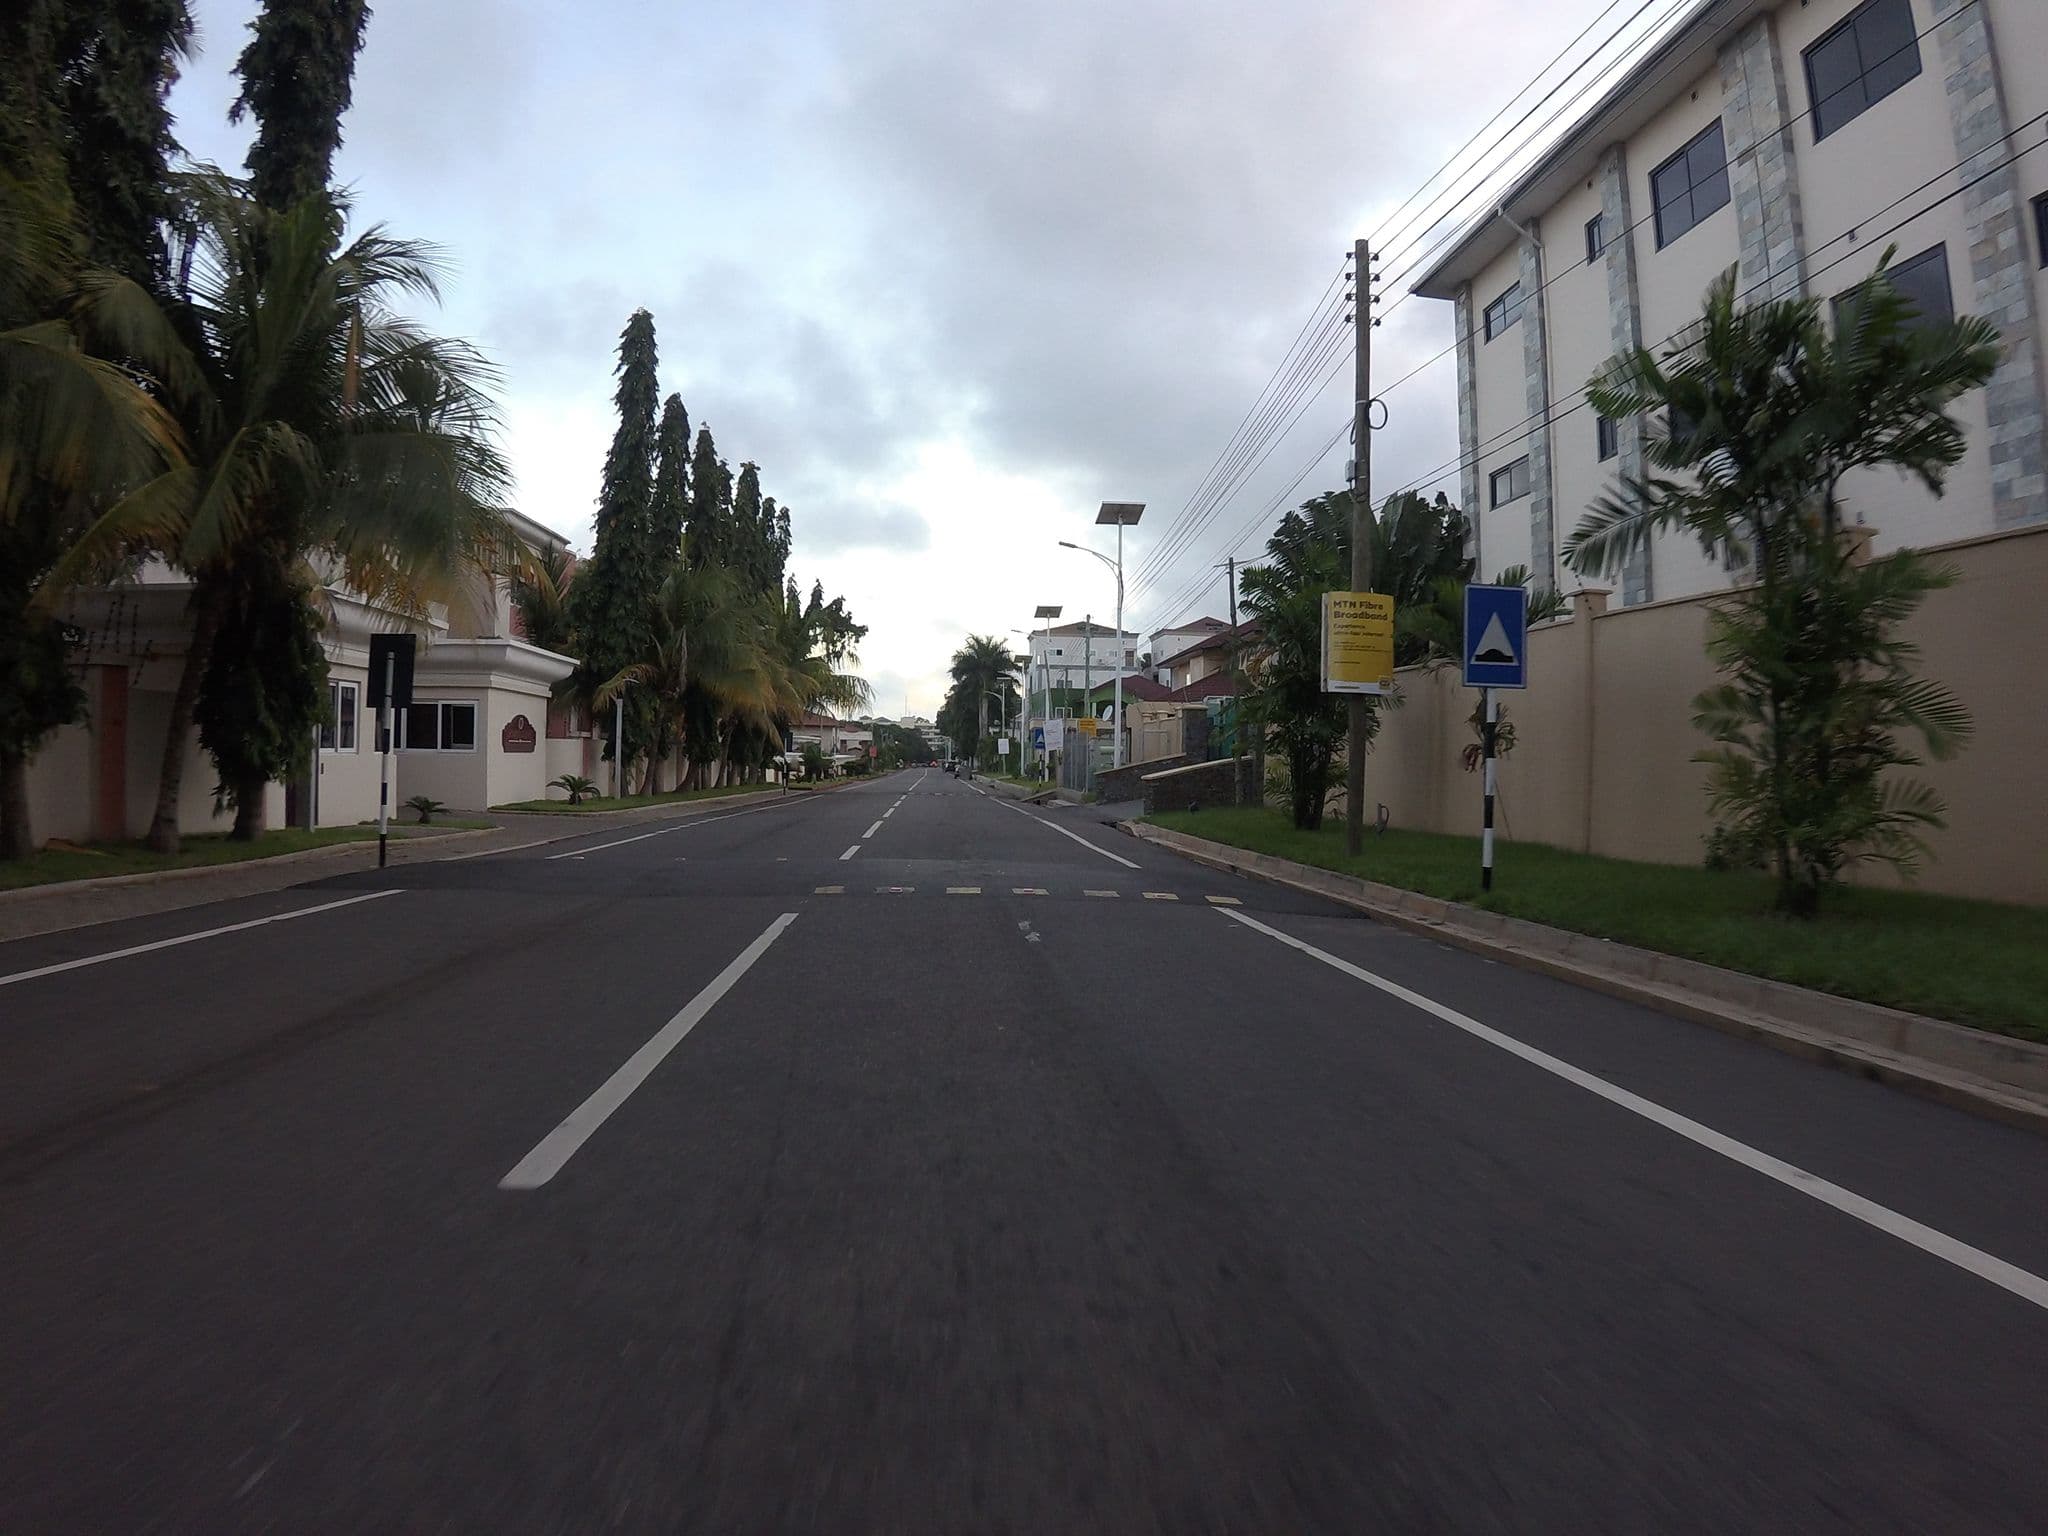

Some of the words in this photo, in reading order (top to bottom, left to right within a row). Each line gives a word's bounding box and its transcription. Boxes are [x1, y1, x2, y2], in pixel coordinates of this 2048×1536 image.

[1334, 600, 1357, 608] MTN
[1359, 601, 1384, 610] Fibre
[1334, 611, 1388, 620] Broadband
